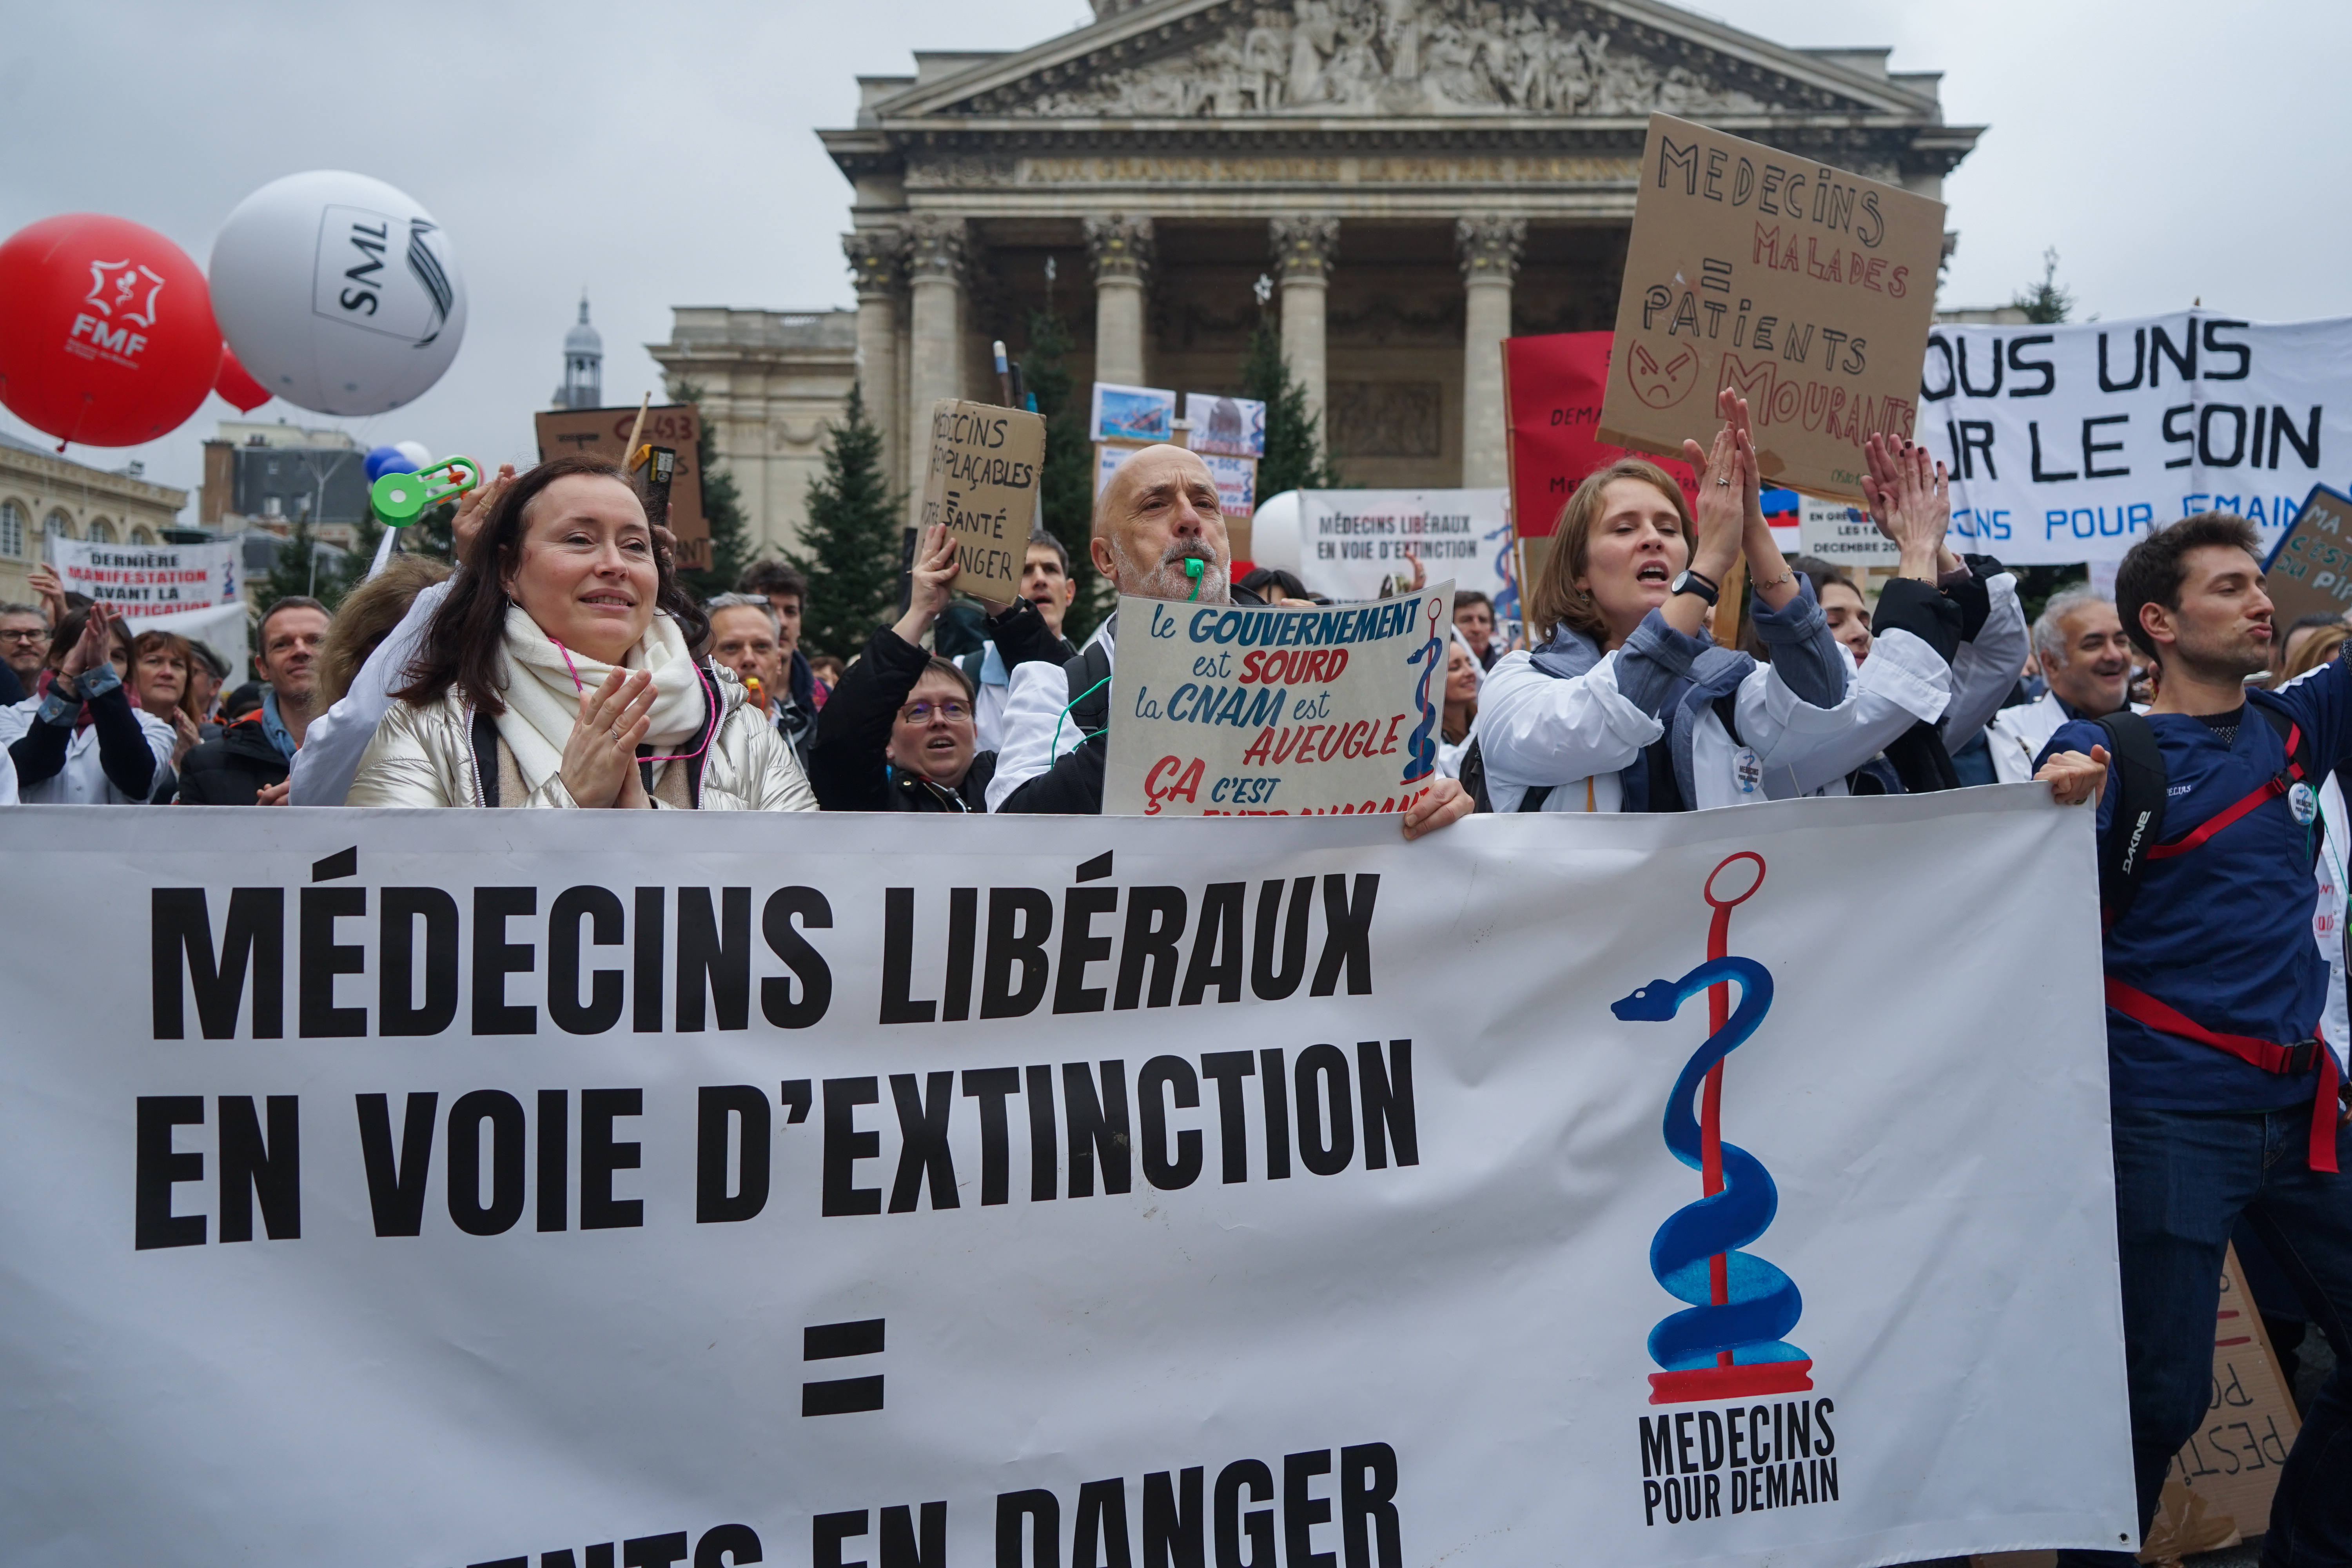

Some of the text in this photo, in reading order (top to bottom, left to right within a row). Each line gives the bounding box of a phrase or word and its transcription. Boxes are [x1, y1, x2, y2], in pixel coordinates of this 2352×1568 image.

[339, 221, 388, 316] SML
[1753, 221, 1909, 298] MALADES
[71, 312, 148, 357] FMF
[1922, 317, 2250, 402] OUS UNS
[1934, 403, 2322, 483] UR LE SOIN
[942, 508, 1007, 539] SANTÉ
[1319, 510, 1471, 534] MÉDECINS LIBÉRAUX
[1838, 526, 1860, 535] LES
[2046, 501, 2153, 540] POUR
[91, 550, 180, 567] DERNIÈRE
[1318, 540, 1477, 559] EN VOIE D'EXTINCTION
[1813, 543, 1879, 553] DECEMBRE
[67, 565, 207, 584] MANIFESTATION
[93, 586, 180, 600] AVANT LA
[1151, 597, 1421, 647] le GOUVERNEMENT
[1193, 648, 1349, 685] est SOURD
[1135, 683, 1330, 728] la CNAM est
[1243, 714, 1406, 766] AVEUGLE
[1144, 755, 1206, 816] ÇA
[1212, 777, 1281, 804] C'EST
[2122, 810, 2152, 875] DAKINE
[152, 845, 1380, 1040] MÉDECINS LIBÉRAUX
[135, 1095, 301, 1250] EN
[356, 1088, 643, 1237] VOIE
[1639, 1398, 1835, 1477] MEDECINS
[1643, 1457, 1839, 1526] POUR DEMAIN
